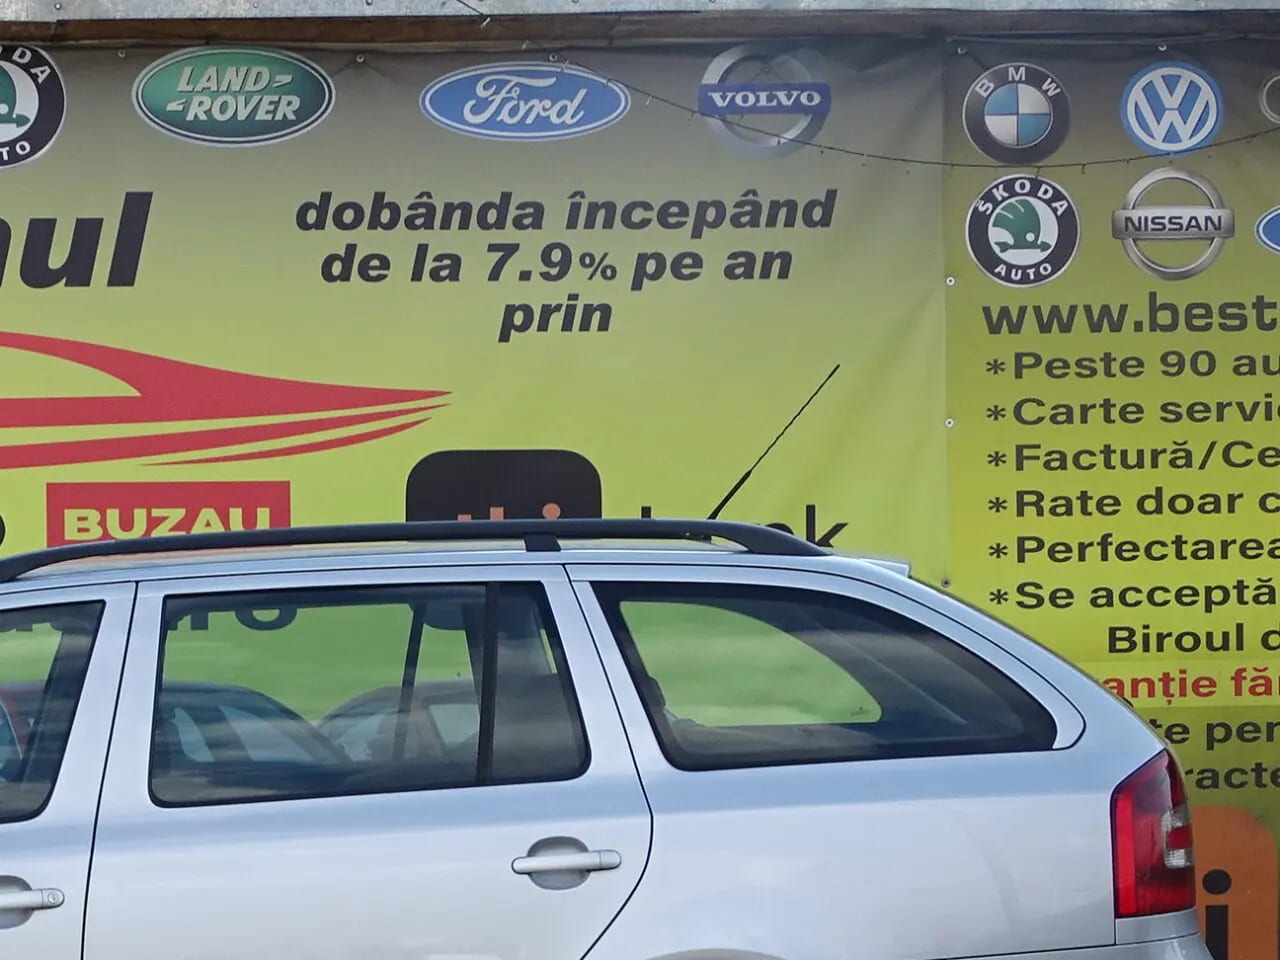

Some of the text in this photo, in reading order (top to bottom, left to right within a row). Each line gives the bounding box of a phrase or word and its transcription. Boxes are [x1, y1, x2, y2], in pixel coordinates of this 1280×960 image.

[177, 65, 276, 92] LAND
[976, 66, 1061, 98] BMW
[184, 94, 301, 121] ROVER
[463, 74, 586, 126] Ford
[707, 90, 821, 108] VOLVO
[296, 189, 838, 239] dobânda începând
[1123, 215, 1223, 234] NISSAN
[321, 242, 793, 291] de la 7.9% pe an
[995, 262, 1053, 281] AUTO
[498, 293, 612, 344] prin
[982, 291, 1277, 335] www.best
[1160, 350, 1216, 377] 90
[1159, 393, 1280, 424] servi
[1136, 486, 1243, 516] doar
[64, 507, 270, 540] BUZAU
[1089, 577, 1277, 613] acceptă
[1108, 623, 1244, 653] Biroul
[1231, 666, 1280, 697] fă
